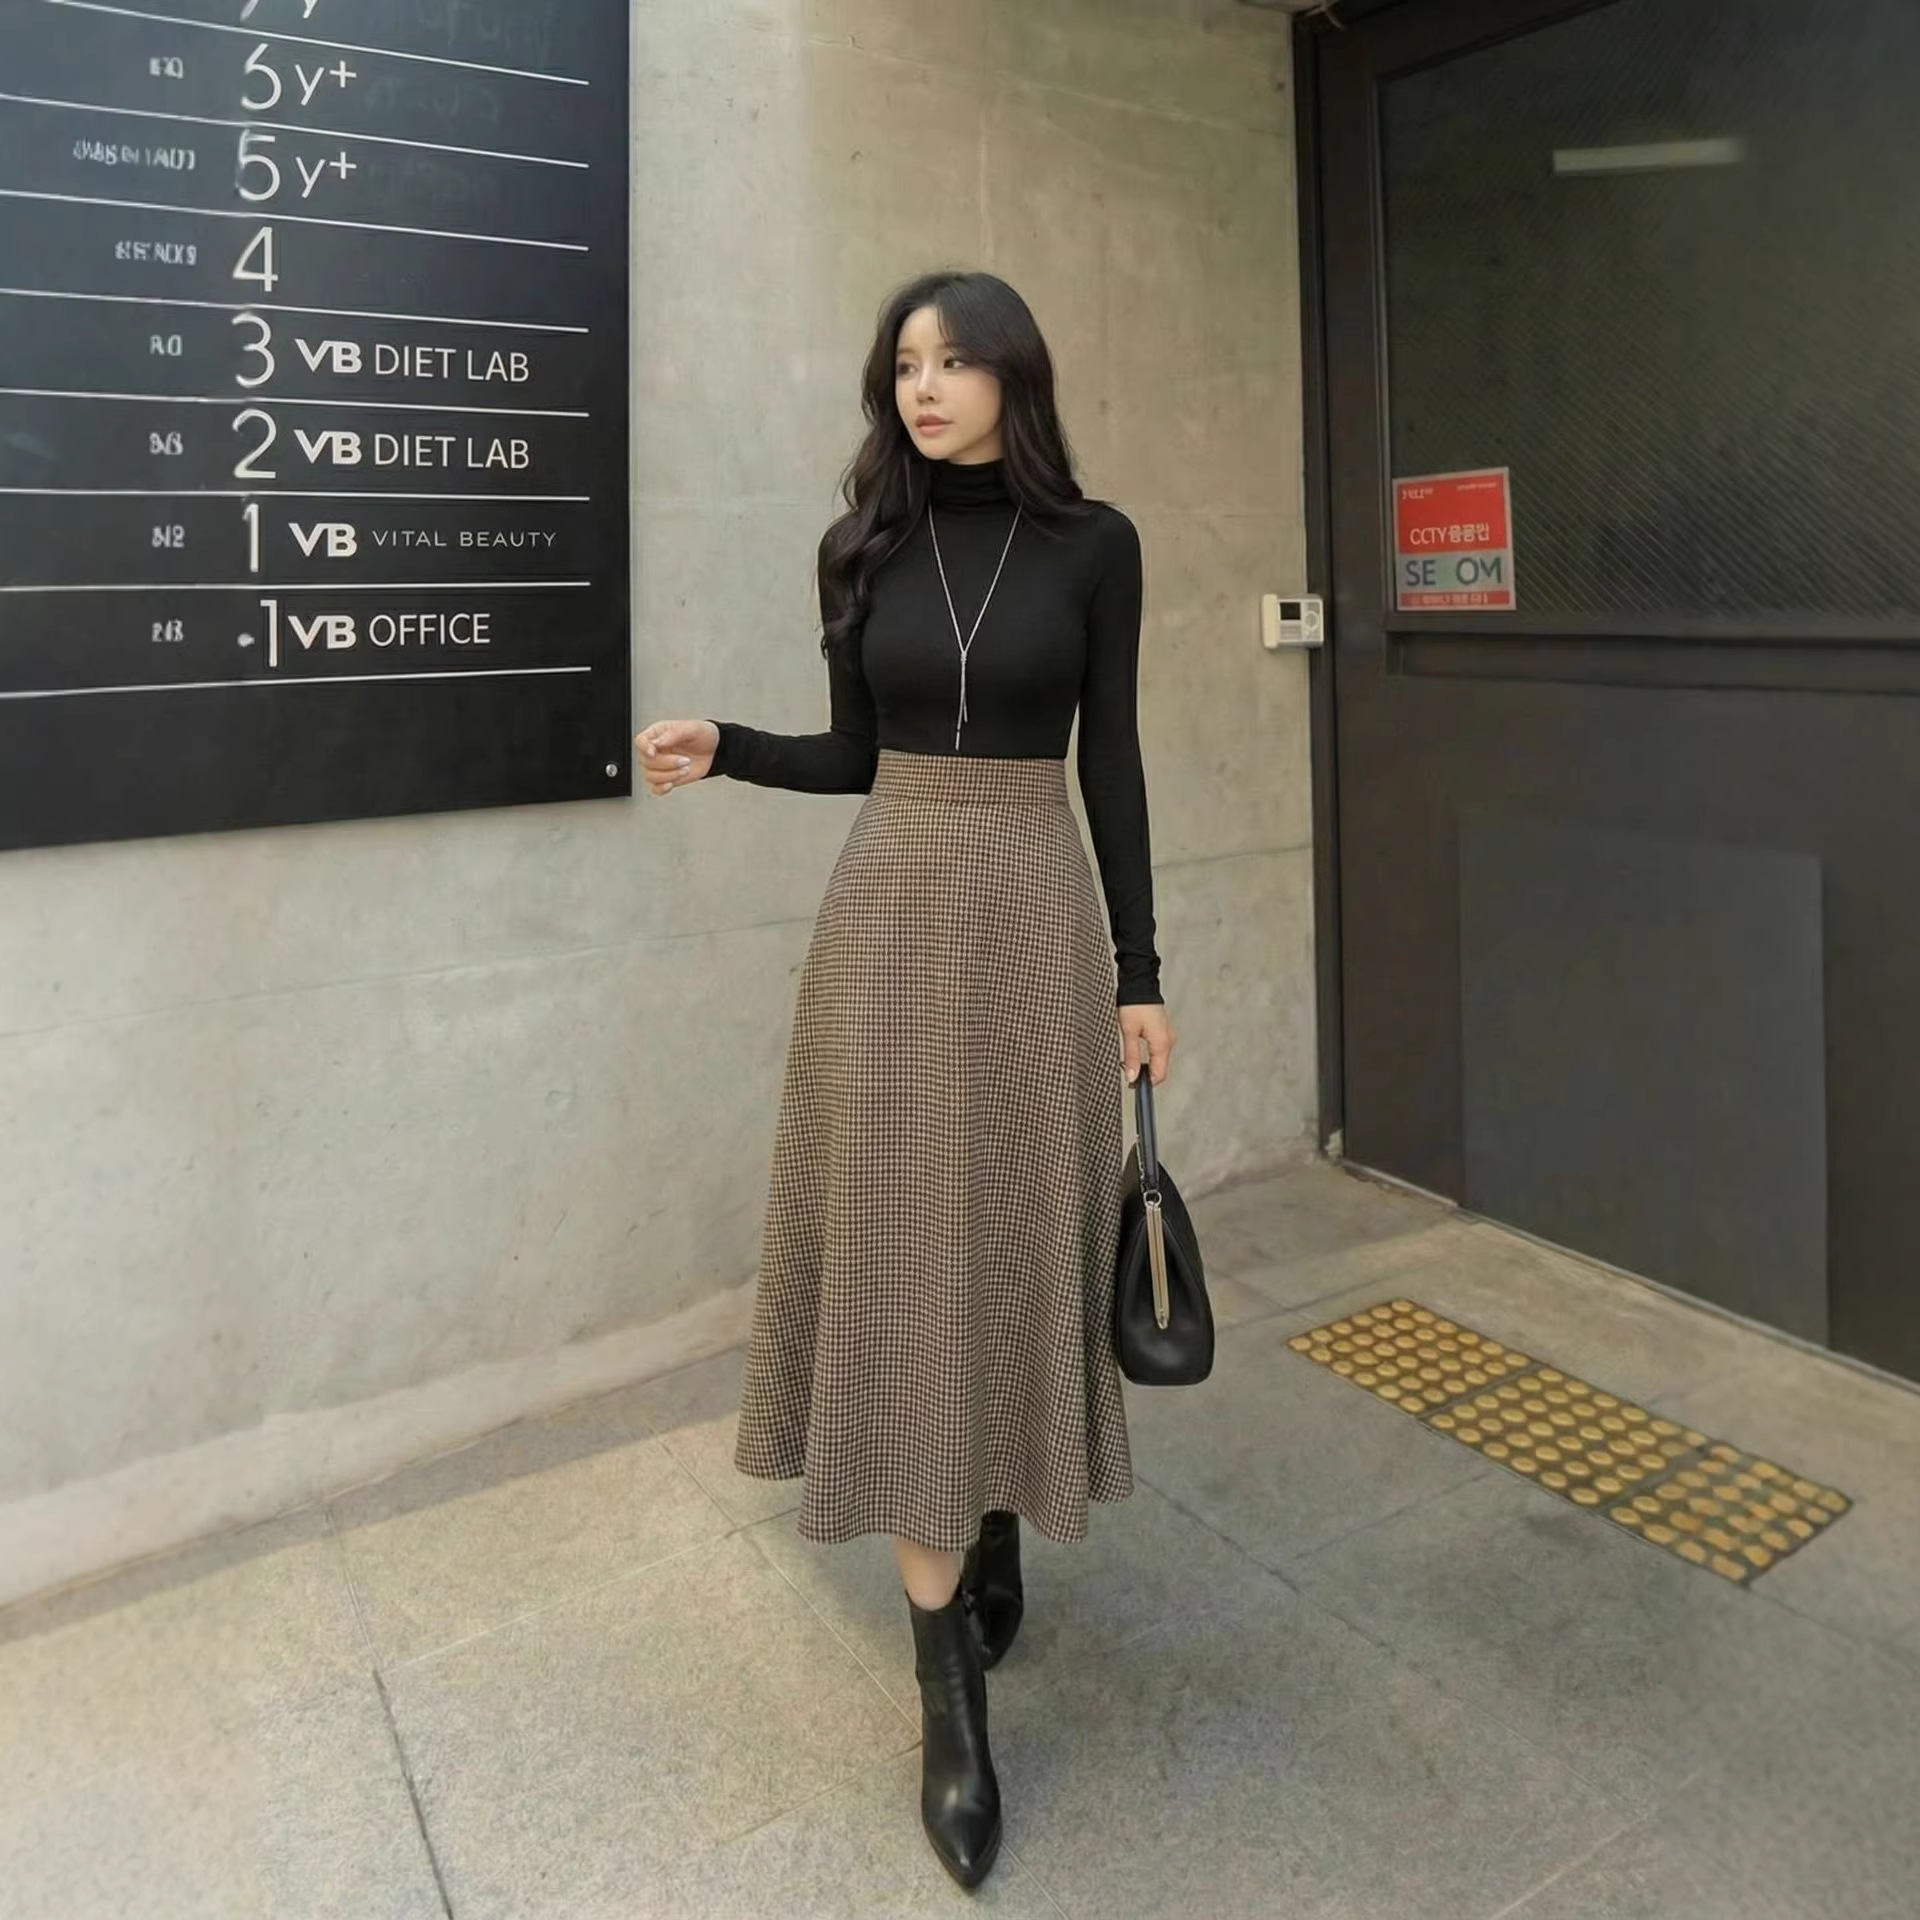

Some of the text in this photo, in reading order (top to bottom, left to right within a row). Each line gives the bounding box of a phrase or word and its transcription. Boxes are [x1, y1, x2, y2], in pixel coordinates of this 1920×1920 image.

[236, 128, 281, 202] 5
[232, 226, 279, 293] 4
[233, 311, 529, 389] 3 VB DIET LAB
[232, 408, 529, 479] 2 VB DIET LAB
[243, 502, 557, 573] 1 VB VITAL BEAUTY
[287, 615, 357, 650] VB
[368, 612, 491, 648] OFFICE
